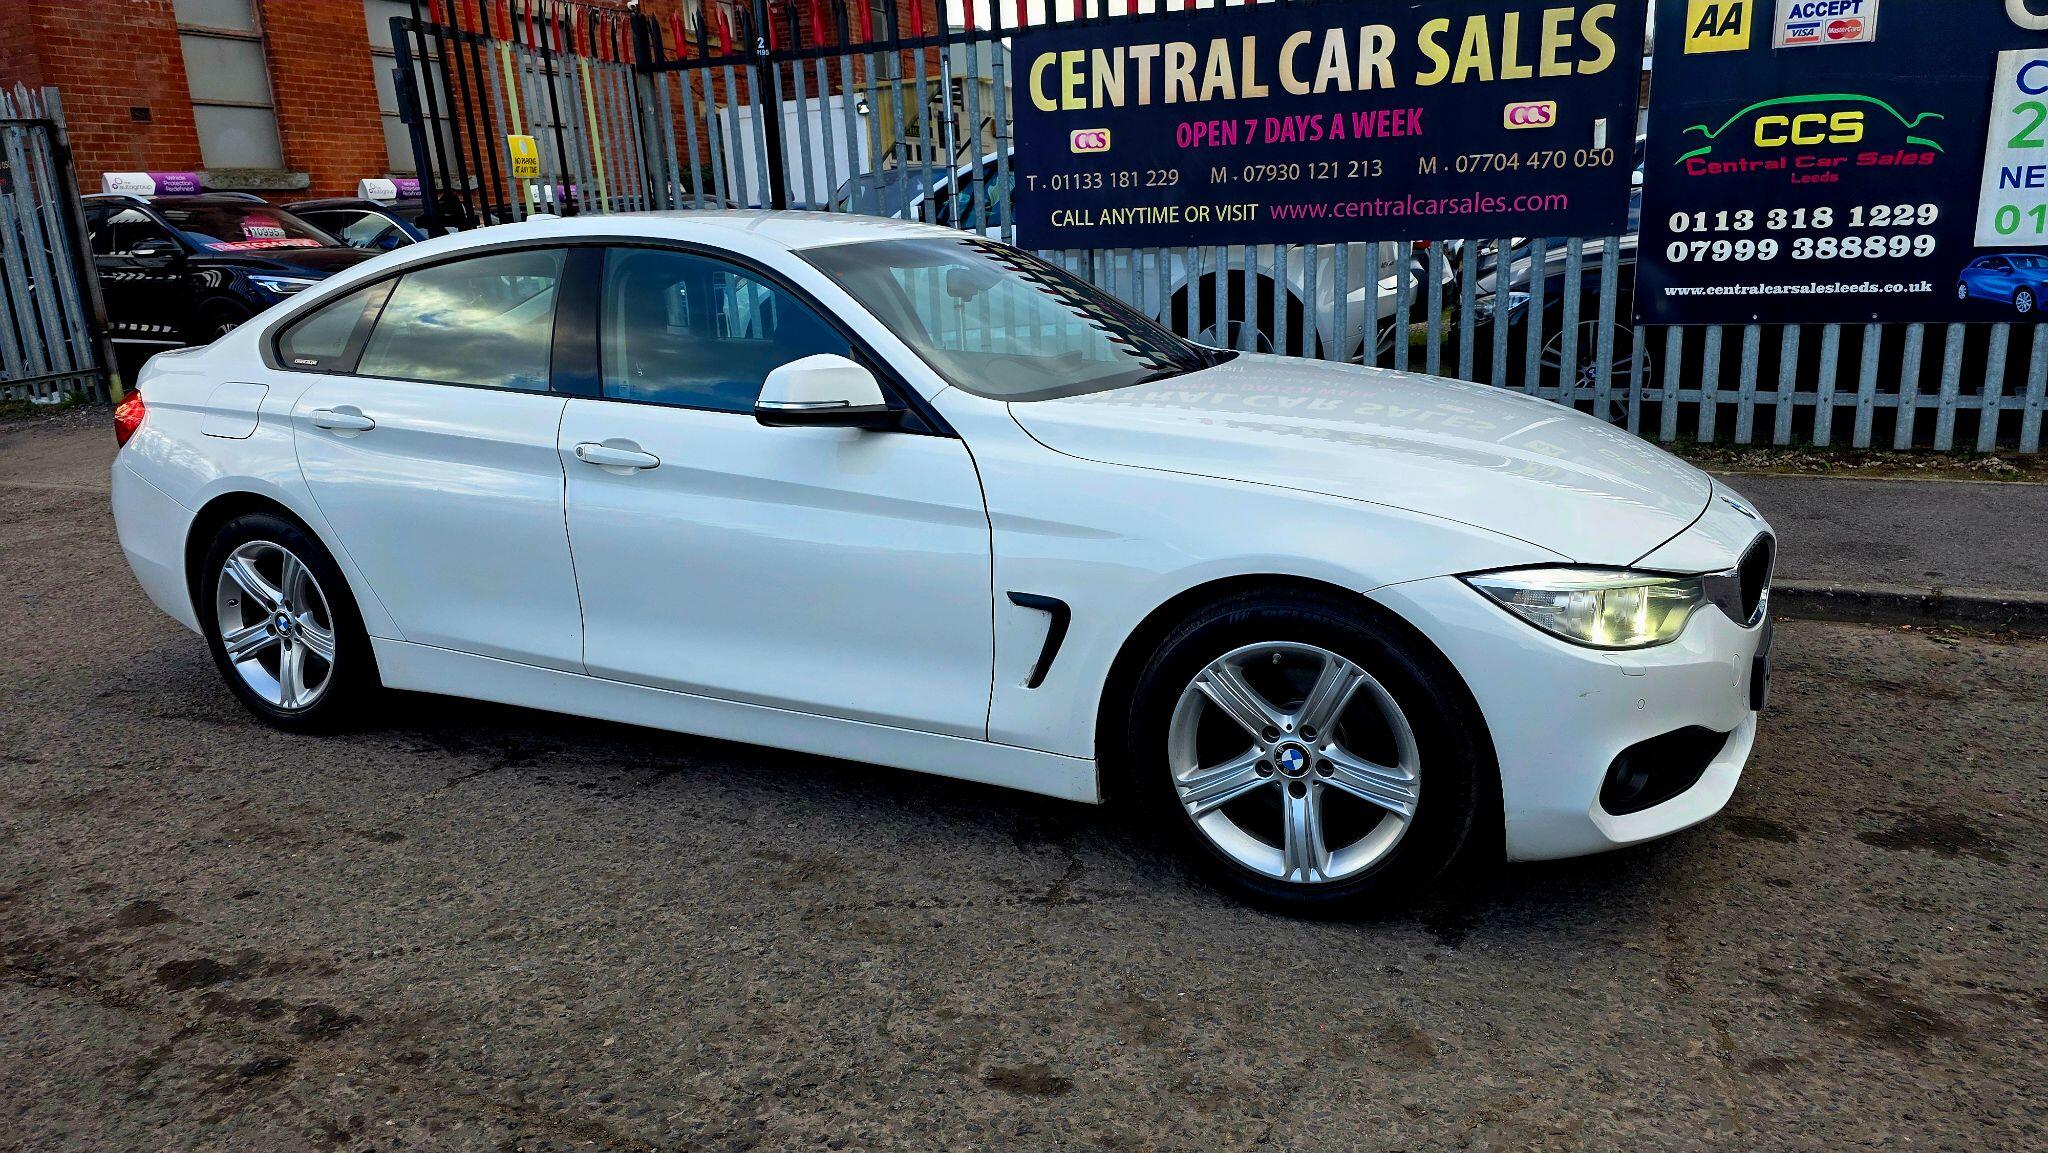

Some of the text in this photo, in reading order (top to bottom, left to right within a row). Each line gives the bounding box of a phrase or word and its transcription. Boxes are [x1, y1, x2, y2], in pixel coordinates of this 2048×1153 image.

[1692, 2, 1743, 38] AA
[1789, 1, 1863, 19] ACCEPT
[757, 36, 765, 48] 2
[1791, 26, 1862, 37] VISA MasterCard
[1029, 3, 1616, 112] CENTRAL CAR SALES
[1176, 107, 1424, 148] OPEN 7 DAYS A WEEK
[1509, 104, 1551, 125] CCS
[2007, 101, 2048, 149] 2
[1074, 132, 1107, 149] CCS
[1754, 111, 1864, 148] CCS
[1243, 163, 1300, 183] 07930
[1308, 161, 1339, 180] 121
[1347, 159, 1383, 178] 213
[1455, 152, 1520, 173] 07704
[1526, 150, 1567, 170] 470
[1573, 147, 1614, 167] 050
[1685, 150, 1936, 176] Central Car Sales
[1051, 173, 1103, 191] 01133
[1109, 171, 1138, 188] 181
[1146, 169, 1179, 187] 229
[1790, 171, 1840, 184] Leeds
[1999, 165, 2047, 189] NE
[1051, 192, 1568, 227] CALL ANYTIME OR VISIT www.centralcarsales.com
[1668, 203, 1939, 233] 0113 318 1229
[1994, 204, 2047, 235] 01
[1666, 234, 1936, 263] 07999 388899
[1664, 280, 1932, 296] www.centralcarsalesleeds.co.uk
